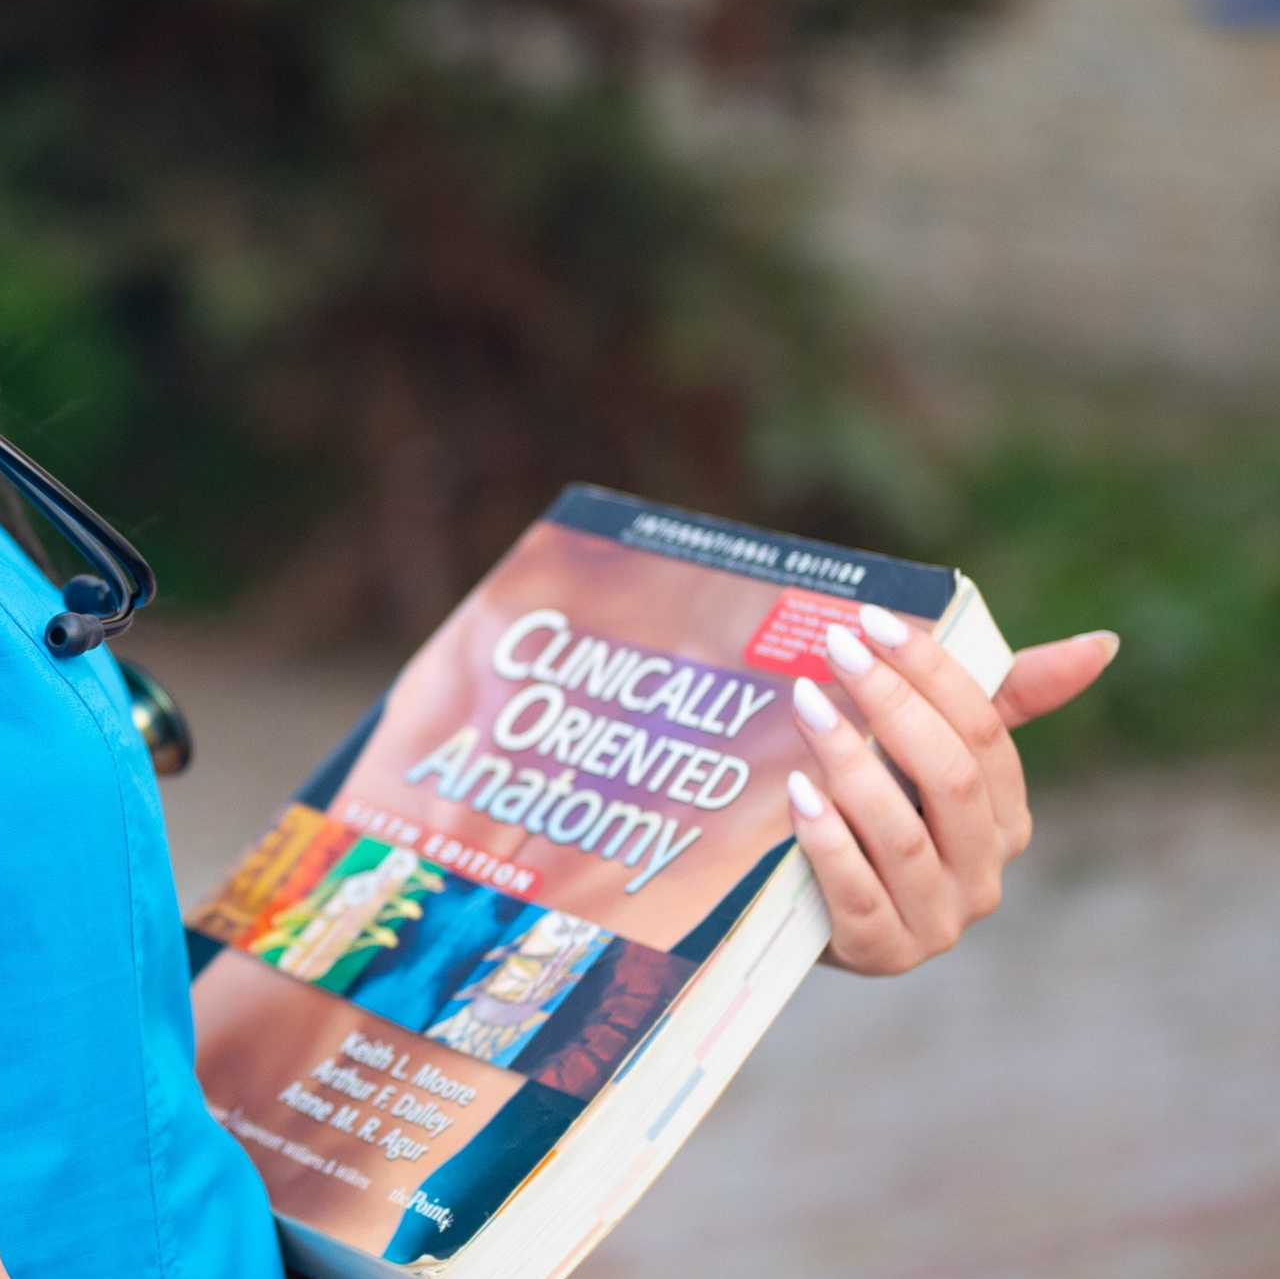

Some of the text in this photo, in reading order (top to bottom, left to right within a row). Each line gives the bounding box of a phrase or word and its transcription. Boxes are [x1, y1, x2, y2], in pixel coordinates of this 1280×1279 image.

[784, 551, 867, 586] EDITION
[492, 608, 776, 739] CLINICALLY
[493, 682, 750, 811] ORIENTED
[404, 725, 703, 895] Anatomy
[423, 833, 536, 894] EDITION
[310, 1058, 454, 1140] Arthur F. Dalley
[340, 1031, 395, 1070] Keith
[411, 1063, 478, 1107] Moore
[277, 1080, 429, 1162] Anne M. R. Agur
